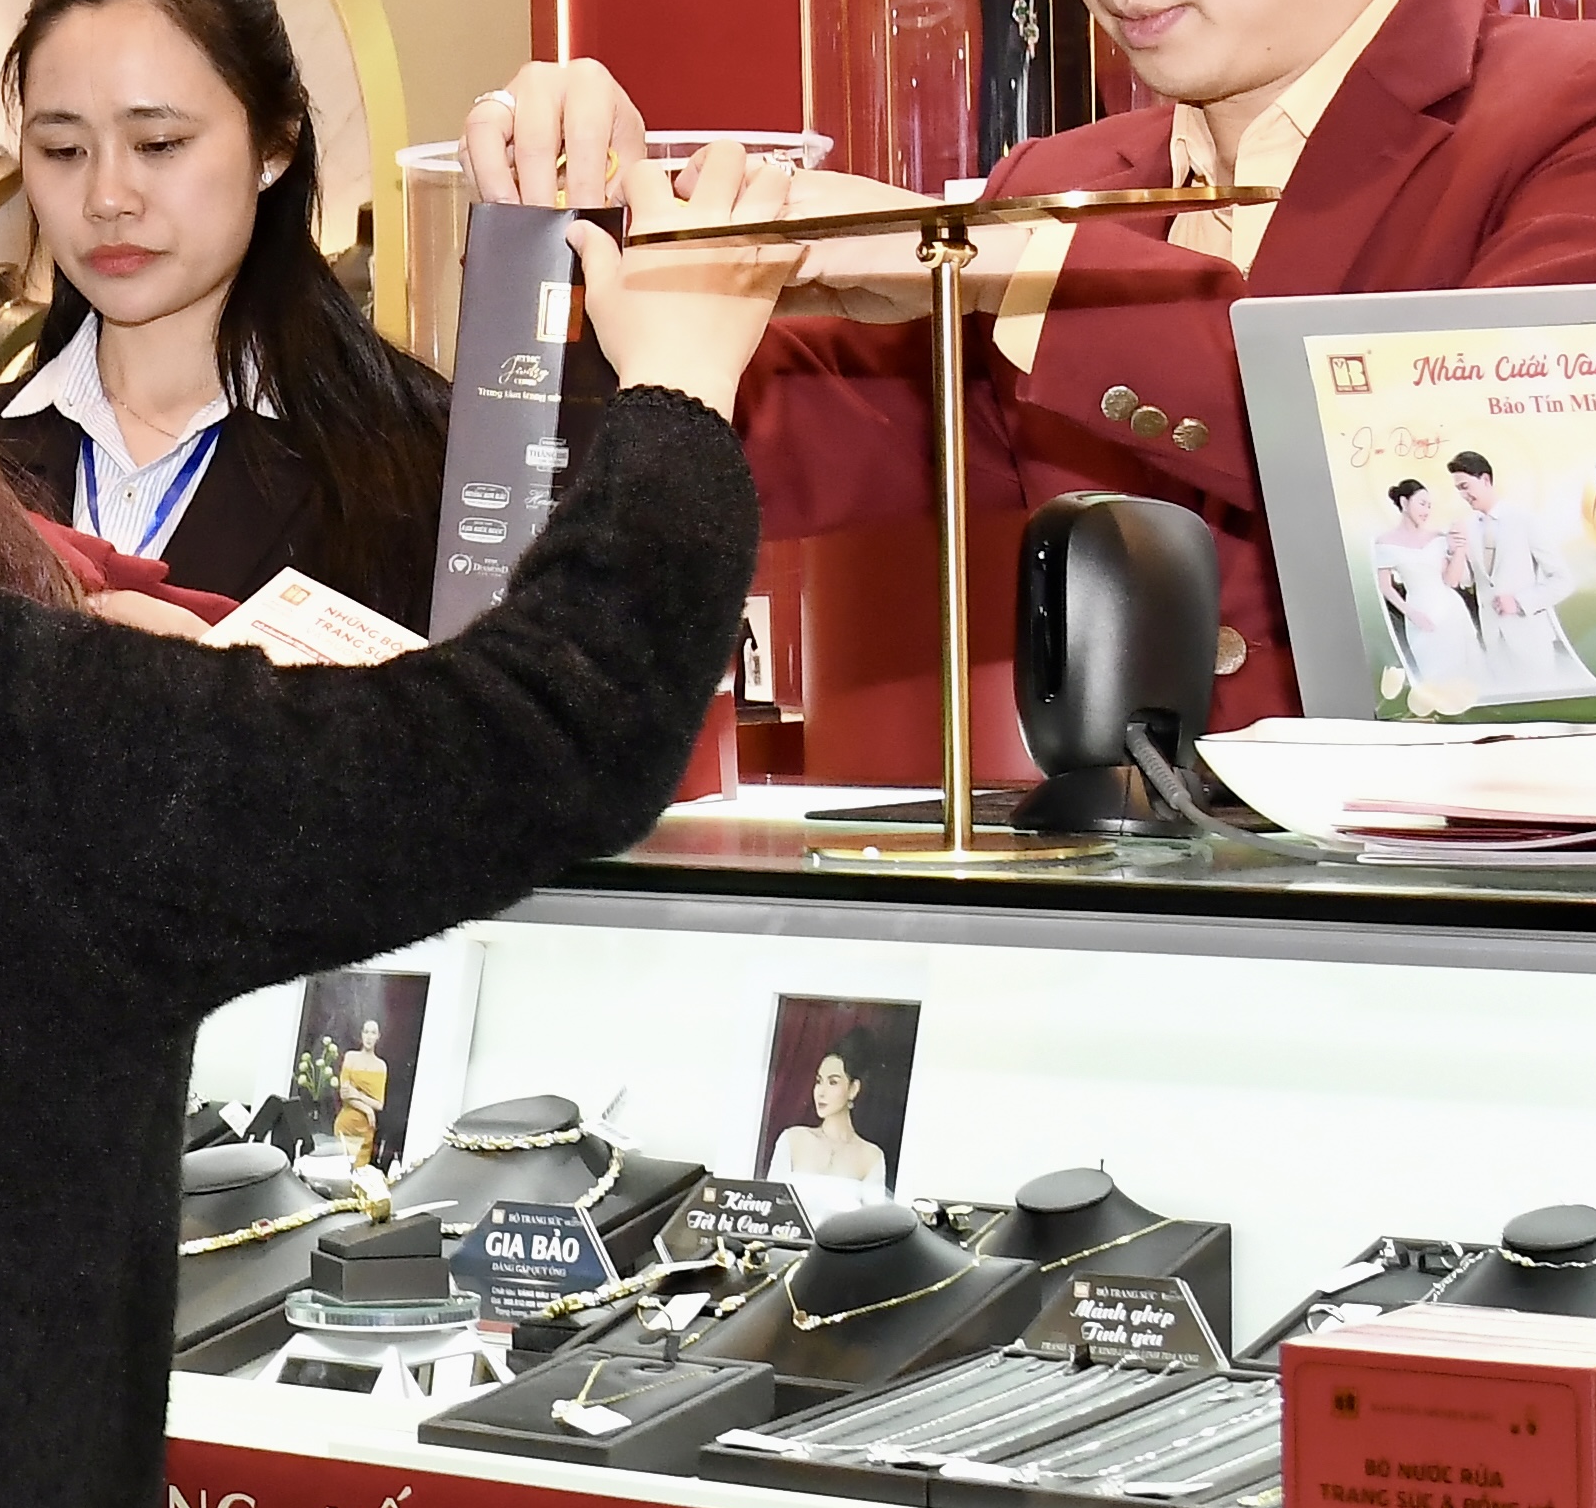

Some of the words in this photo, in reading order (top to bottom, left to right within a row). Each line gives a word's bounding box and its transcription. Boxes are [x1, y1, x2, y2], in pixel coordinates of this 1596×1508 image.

[1412, 352, 1485, 387] Nhẫn
[1494, 353, 1549, 384] Cưới
[1488, 393, 1526, 416] Bảo
[1529, 394, 1565, 414] Tín
[531, 1228, 580, 1264] BẢO
